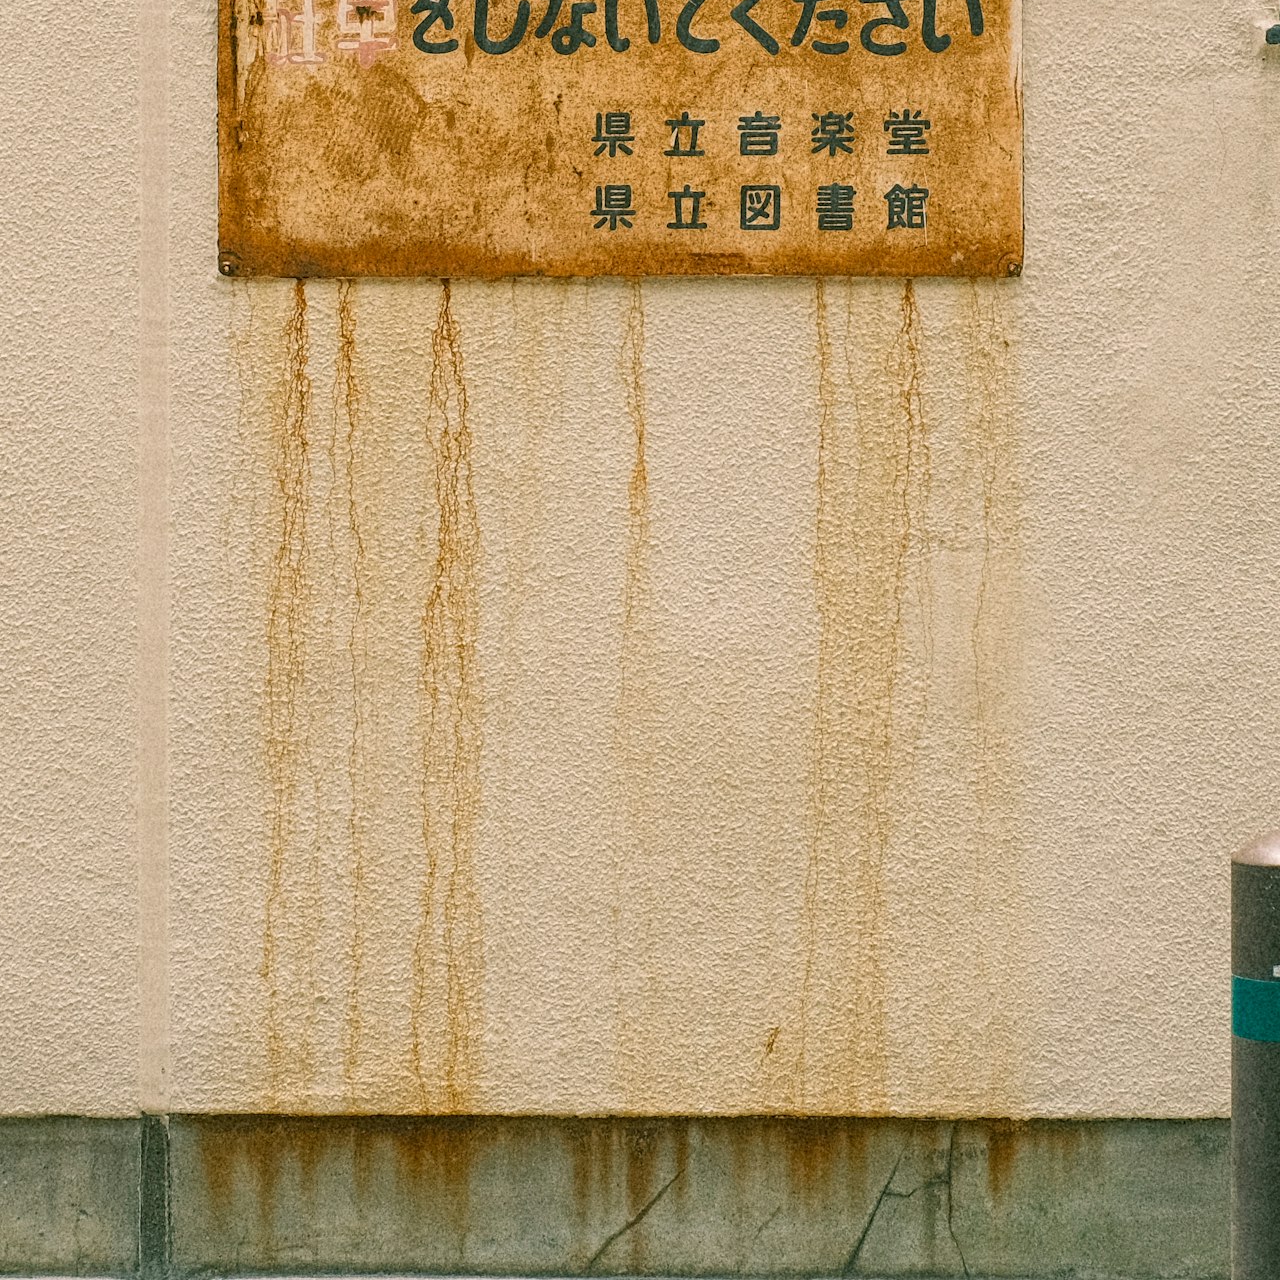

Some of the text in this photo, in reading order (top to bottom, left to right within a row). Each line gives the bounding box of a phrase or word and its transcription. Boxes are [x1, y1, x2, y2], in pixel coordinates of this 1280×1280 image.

[591, 111, 931, 157] 県立音楽堂
[590, 182, 930, 231] 県立図書館
